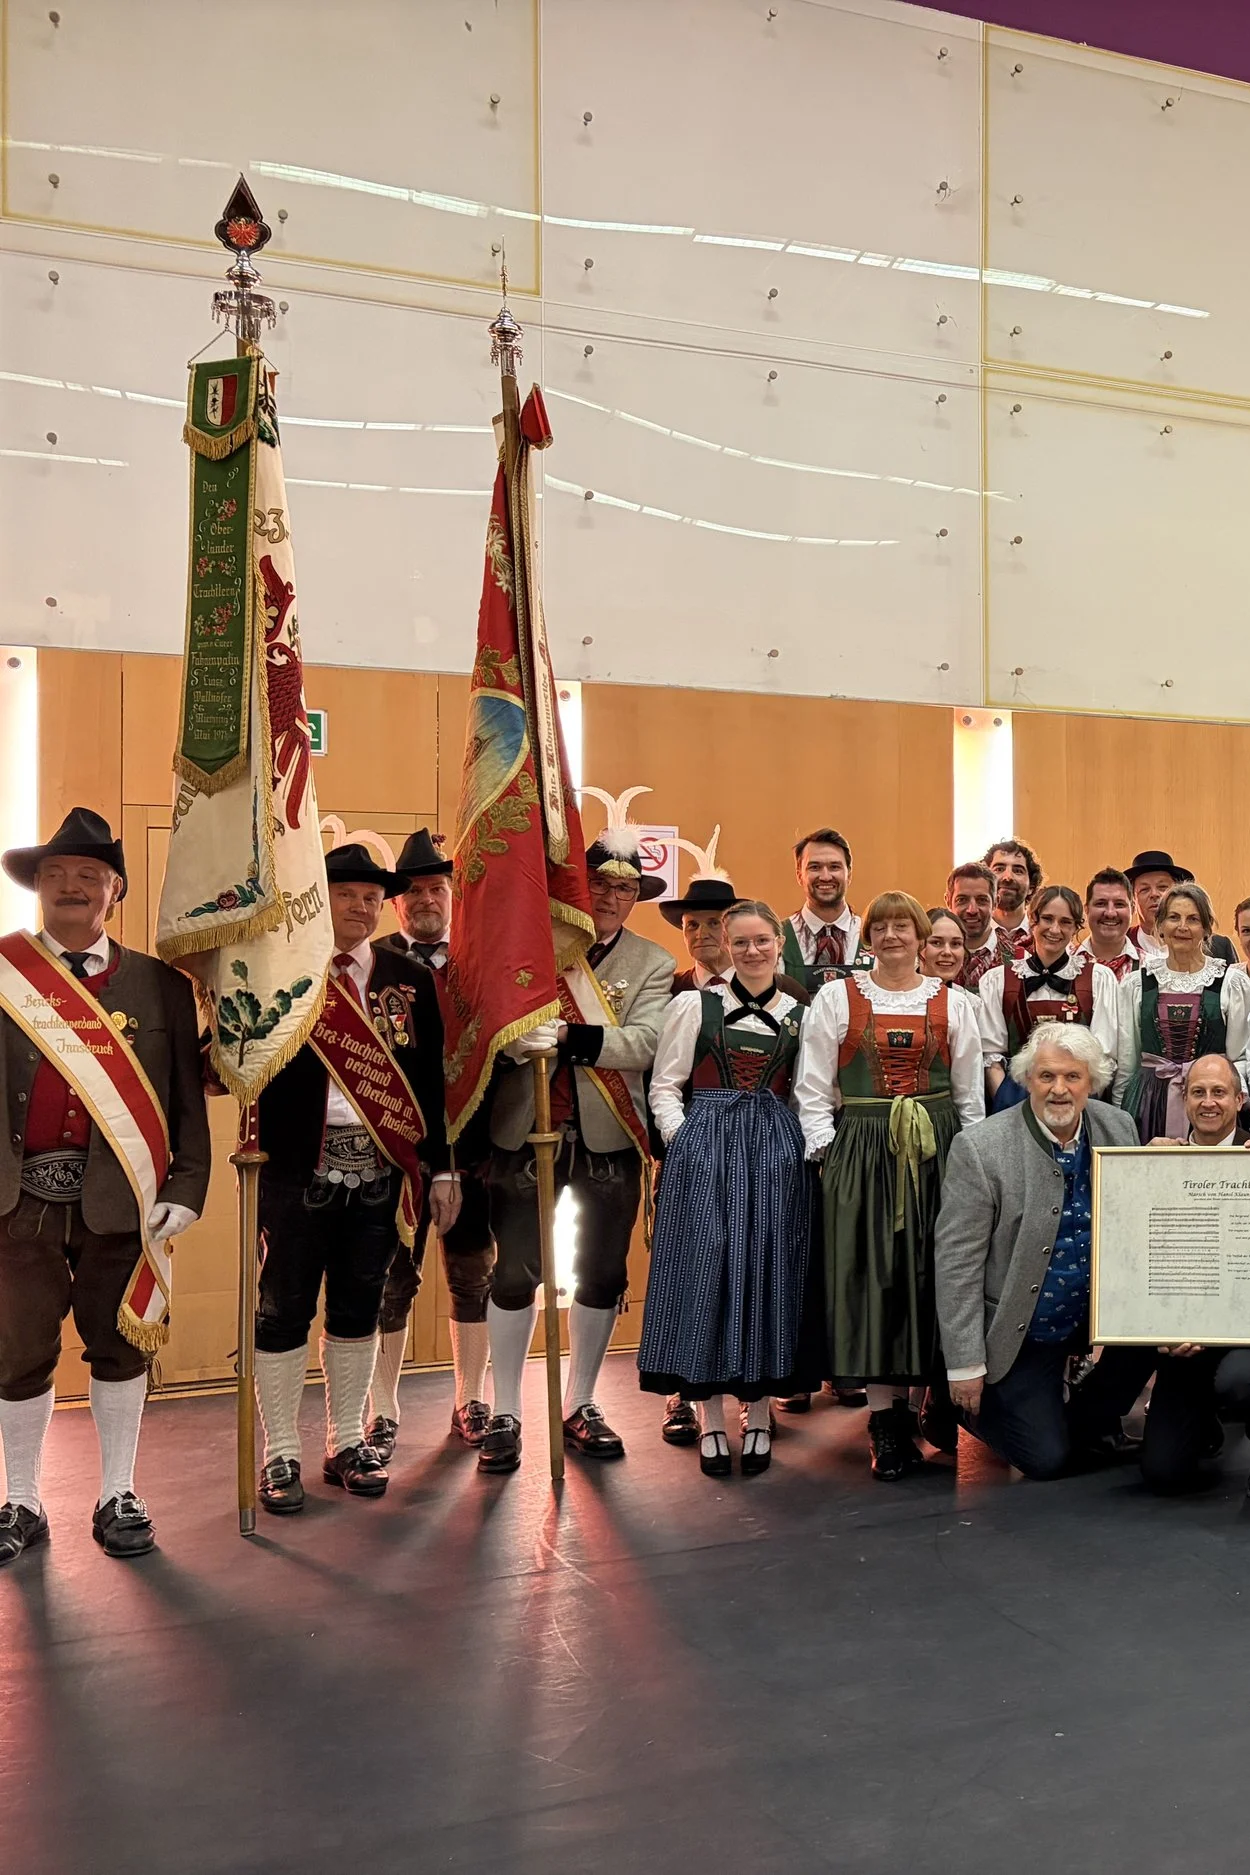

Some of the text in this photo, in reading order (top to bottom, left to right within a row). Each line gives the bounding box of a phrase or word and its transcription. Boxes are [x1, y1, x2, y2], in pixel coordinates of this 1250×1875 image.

[55, 1037, 114, 1056] Innsbruck
[344, 1056, 394, 1087] verband
[1182, 1179, 1217, 1190] Tiroler
